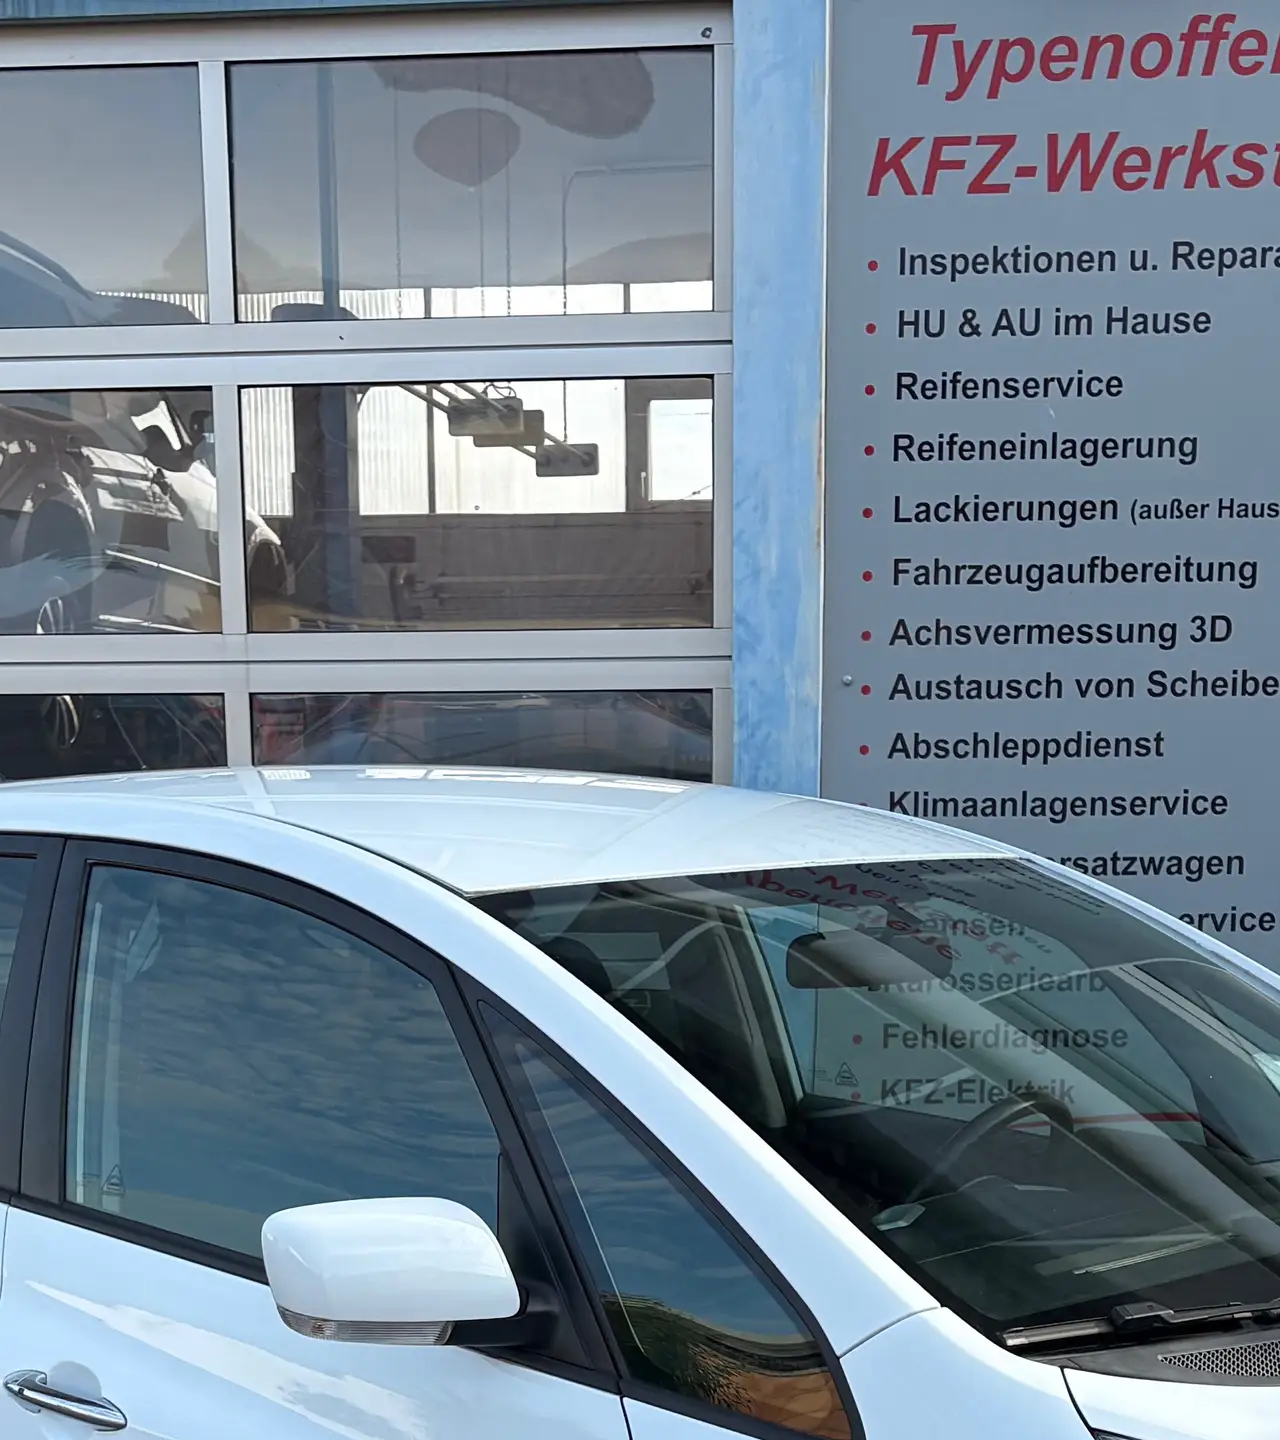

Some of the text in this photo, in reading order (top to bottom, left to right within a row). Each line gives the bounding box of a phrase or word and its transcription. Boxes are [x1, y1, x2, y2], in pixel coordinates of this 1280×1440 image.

[898, 245, 1117, 283] Inspektionen
[1130, 250, 1159, 272] u.
[898, 307, 1213, 339] HU & AU im Hause
[896, 370, 1124, 402] Reifenservice
[893, 432, 1199, 467] Reifeneinlagerung
[894, 495, 1119, 529] Lackierungen
[1130, 498, 1211, 526] (außer
[893, 556, 1259, 592] Fahrzeugaufbereitung
[889, 615, 1234, 651] Achsvermessung 3D
[889, 672, 1064, 702] Austausch
[1075, 679, 1135, 700] von
[888, 731, 1166, 766] Abschleppdienst
[889, 790, 1229, 824] Klimaanlagenservice
[1177, 906, 1277, 933] ervice
[882, 1022, 1129, 1055] Fehlerdiagnose
[880, 1077, 1076, 1106] KFZ-Elektrik
